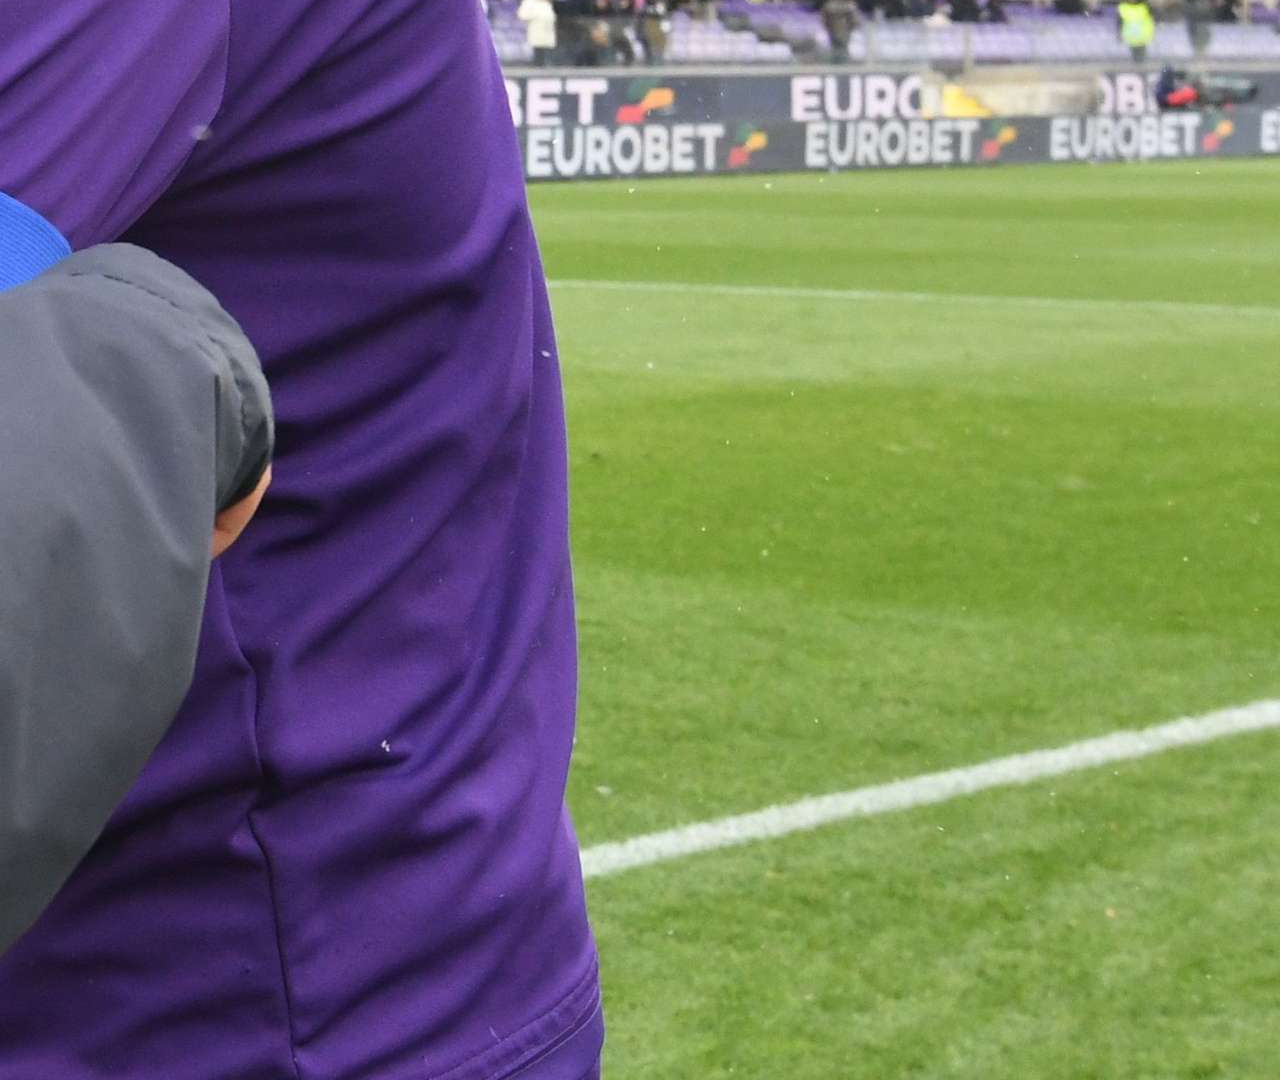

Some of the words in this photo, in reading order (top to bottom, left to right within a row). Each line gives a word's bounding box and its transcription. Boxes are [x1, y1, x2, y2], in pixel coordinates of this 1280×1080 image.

[526, 123, 725, 178] EUROBET
[804, 118, 981, 168] EUROBET
[1049, 112, 1201, 162] EUROBET
